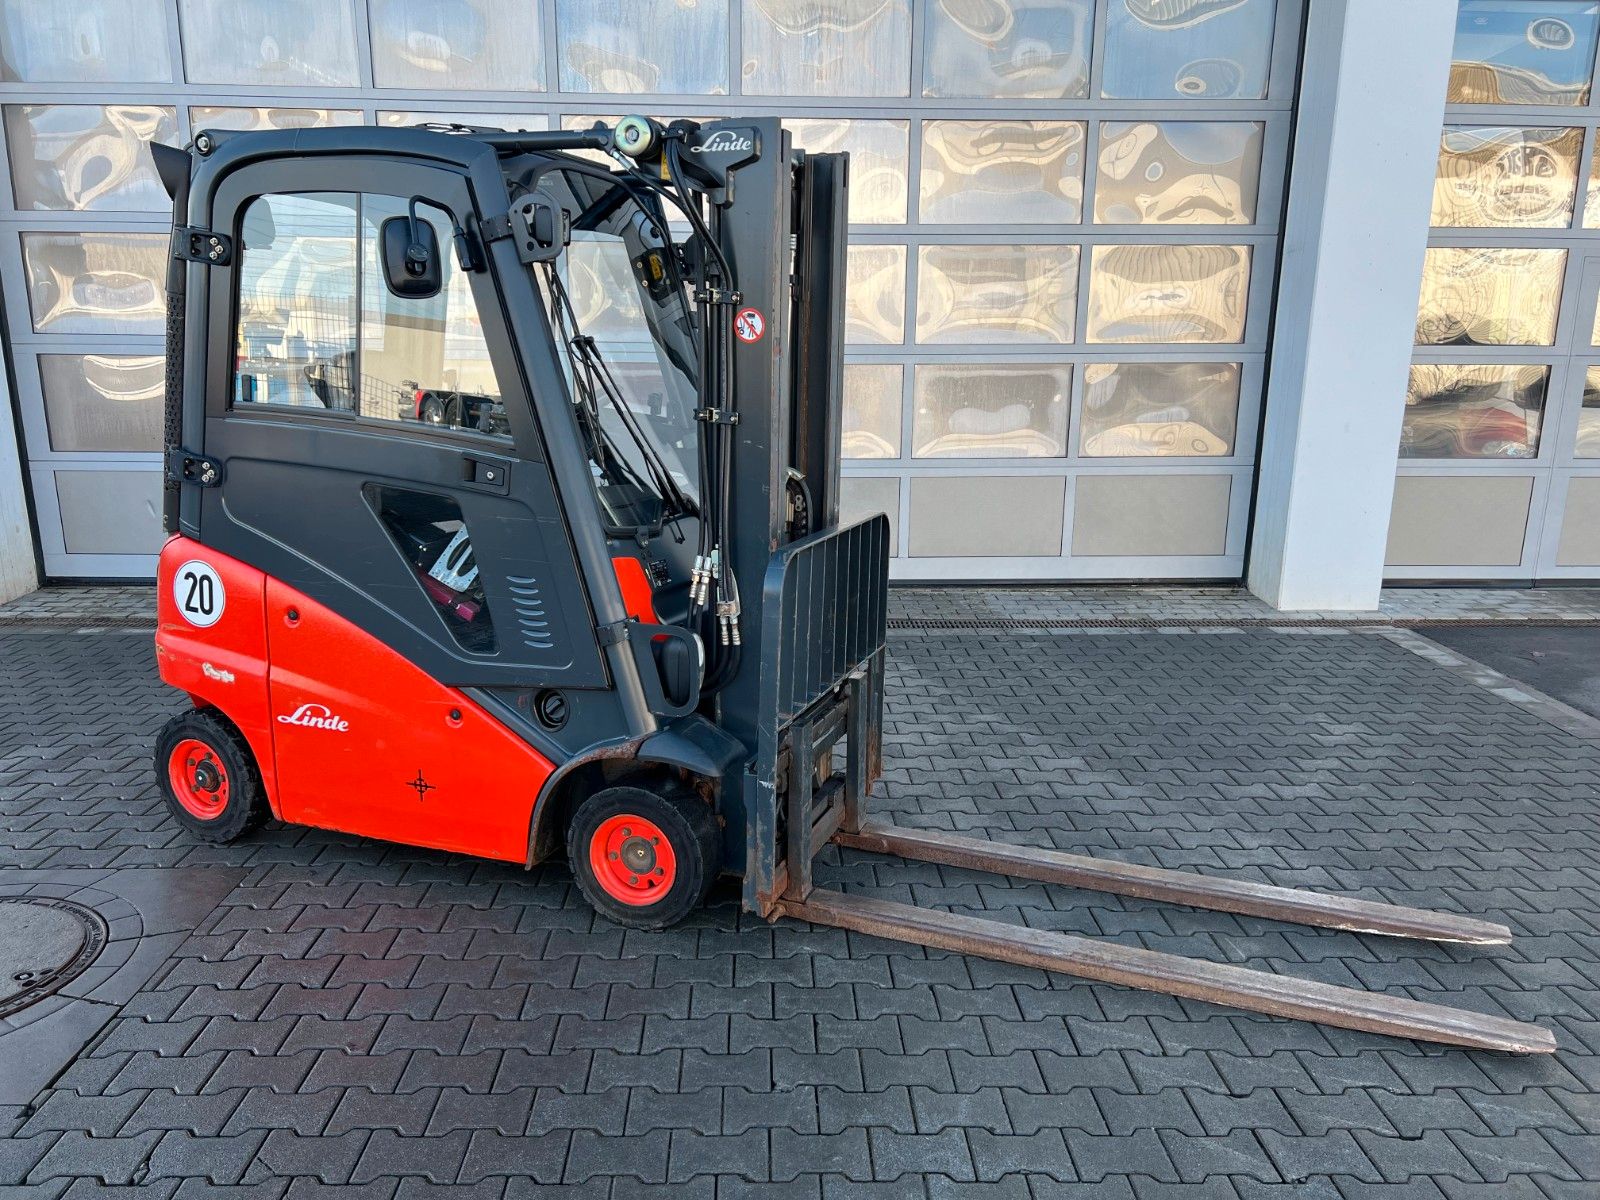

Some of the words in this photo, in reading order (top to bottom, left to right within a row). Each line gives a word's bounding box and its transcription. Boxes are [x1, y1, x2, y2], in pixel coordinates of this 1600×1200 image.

[690, 130, 751, 153] Linde
[184, 571, 214, 615] 20
[277, 703, 349, 732] Linde
